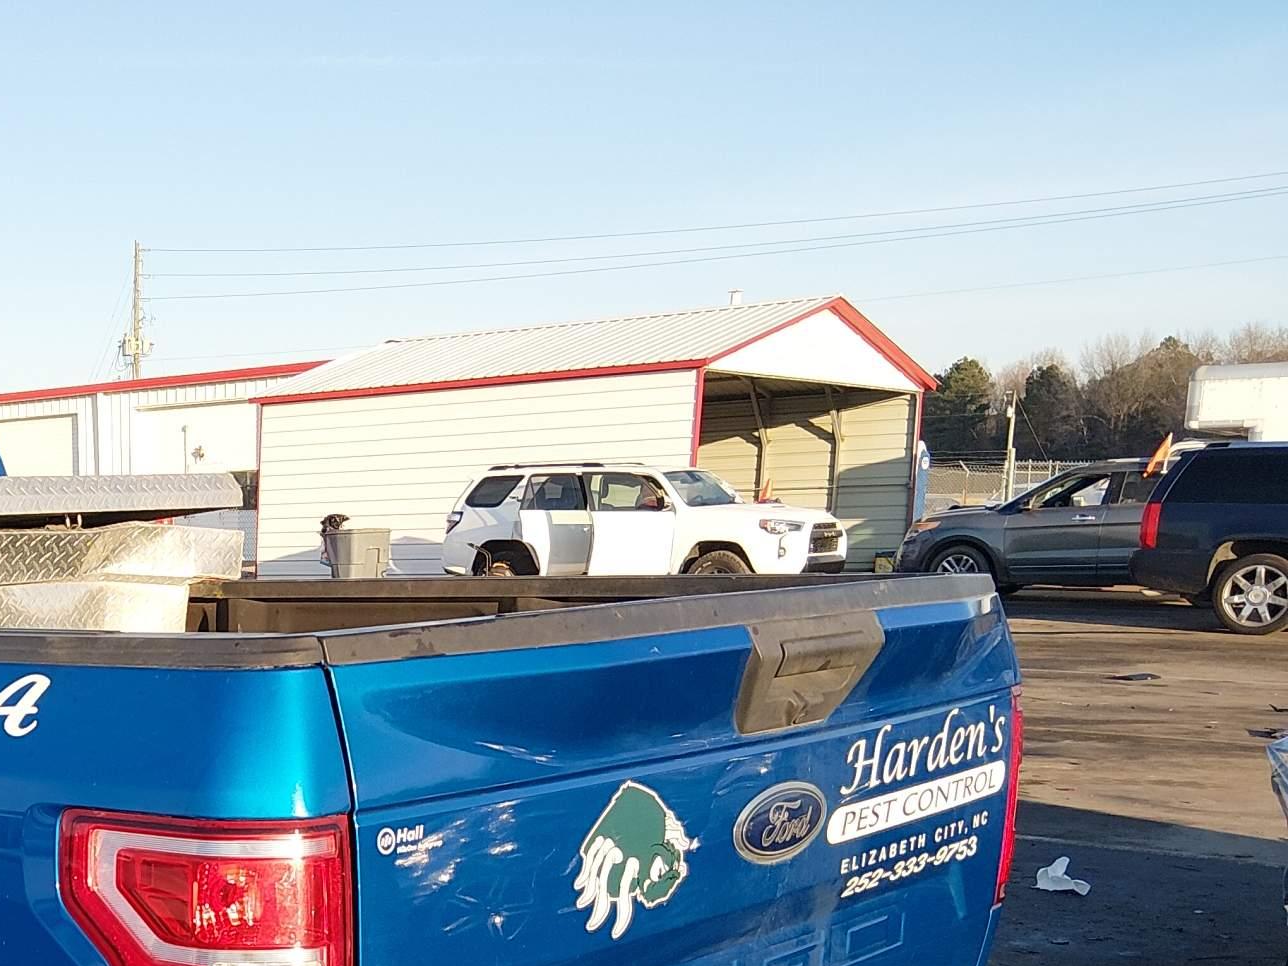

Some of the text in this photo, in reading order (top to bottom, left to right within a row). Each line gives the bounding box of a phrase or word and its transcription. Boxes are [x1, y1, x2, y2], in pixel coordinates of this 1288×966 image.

[839, 705, 1005, 795] Harden's
[396, 824, 424, 844] Hall
[761, 800, 812, 848] Ford
[841, 768, 997, 836] PEST CONTROL
[840, 810, 989, 875] ELIZABETH CITY, NC
[840, 836, 978, 899] 252-333-9753
